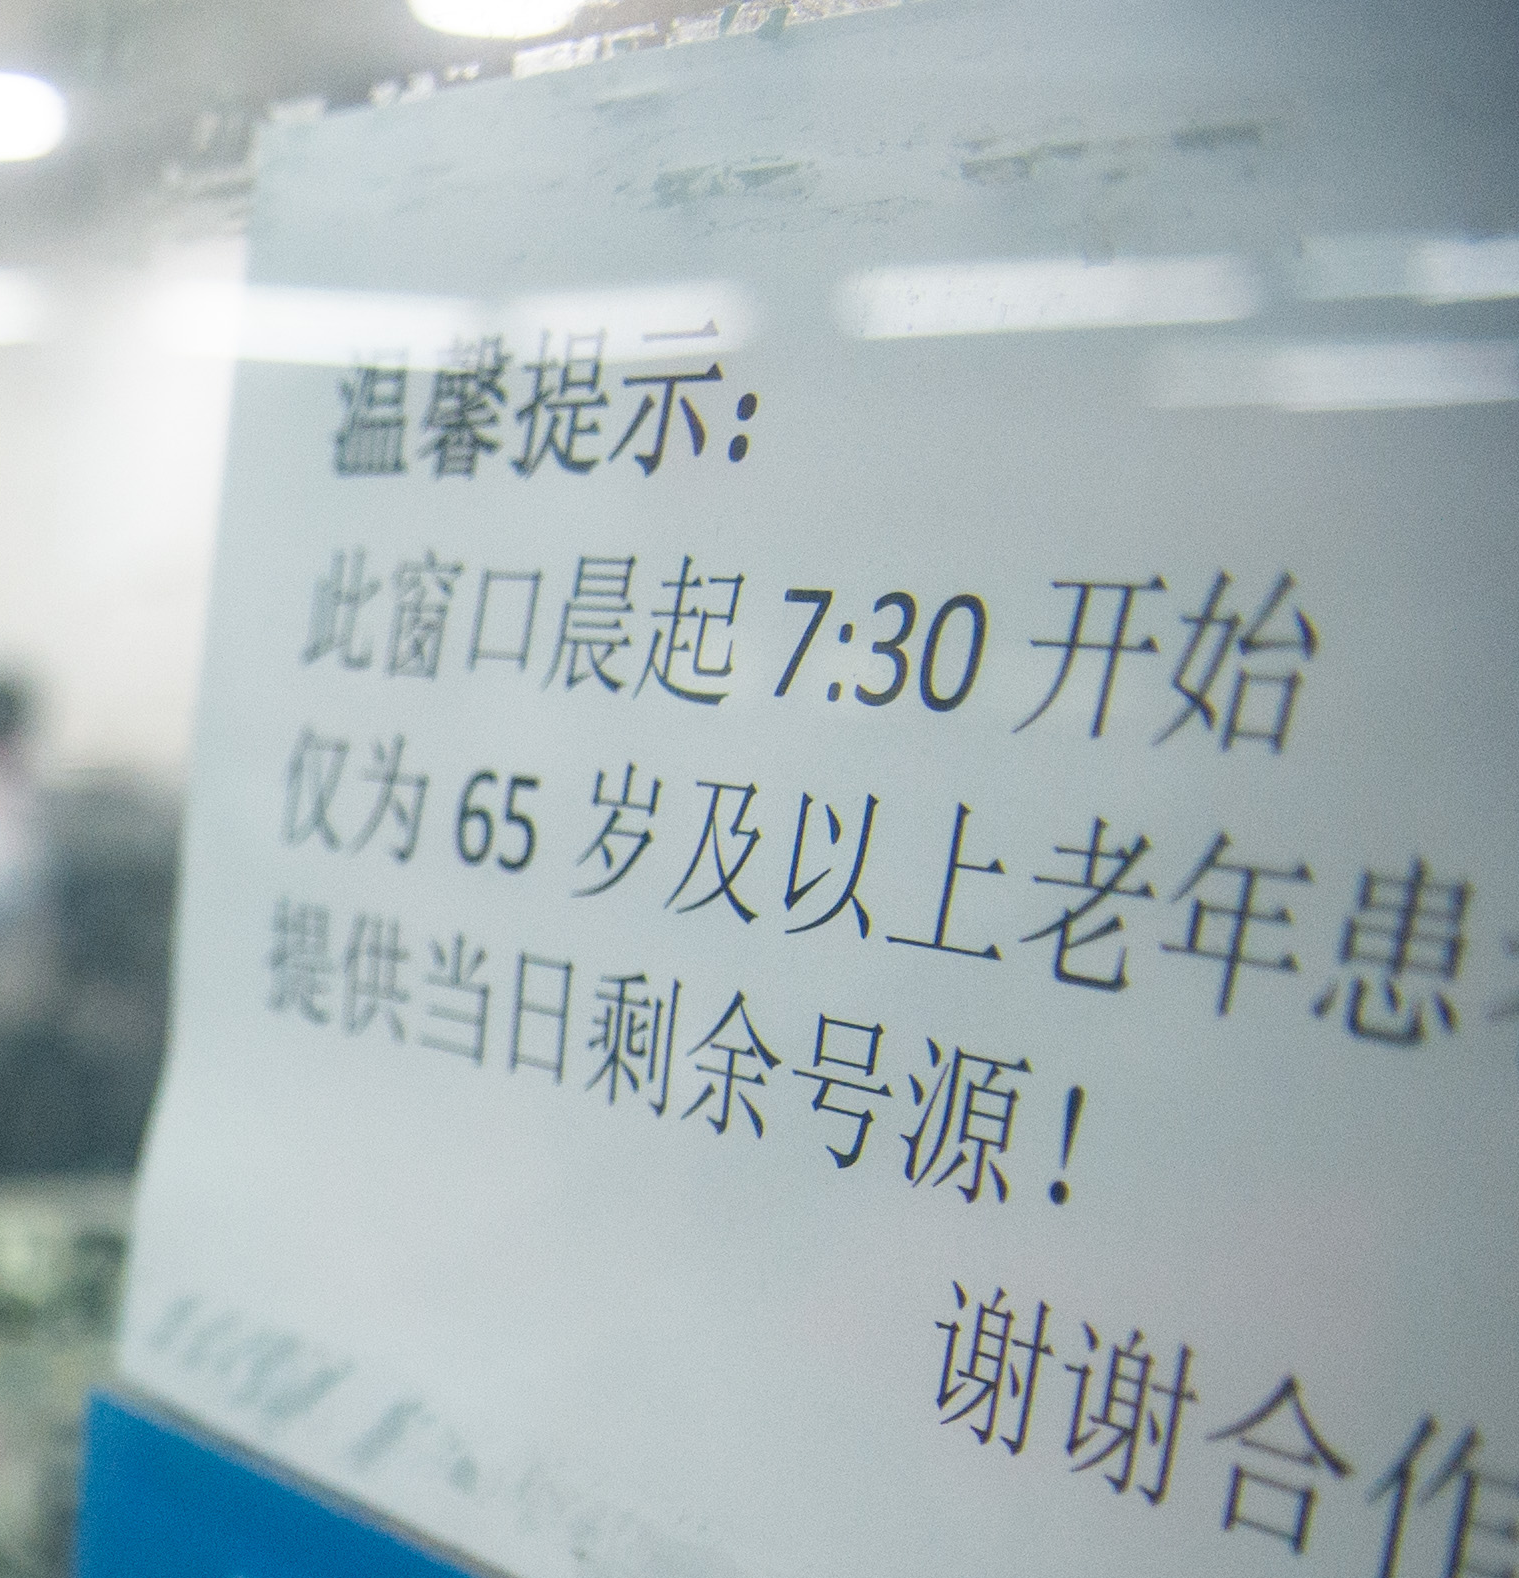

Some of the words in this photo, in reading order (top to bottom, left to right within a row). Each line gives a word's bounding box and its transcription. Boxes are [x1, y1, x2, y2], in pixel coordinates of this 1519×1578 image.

[331, 318, 759, 480] 温馨提示：
[299, 546, 746, 706] 此窗口晨起
[773, 587, 989, 713] 7:30
[1011, 568, 1321, 756] 开始
[280, 727, 430, 866] 仅为
[454, 767, 541, 873] 65
[569, 760, 1519, 1048] 岁及以上老年患
[265, 896, 1087, 1206] 提供当日剩余号源！
